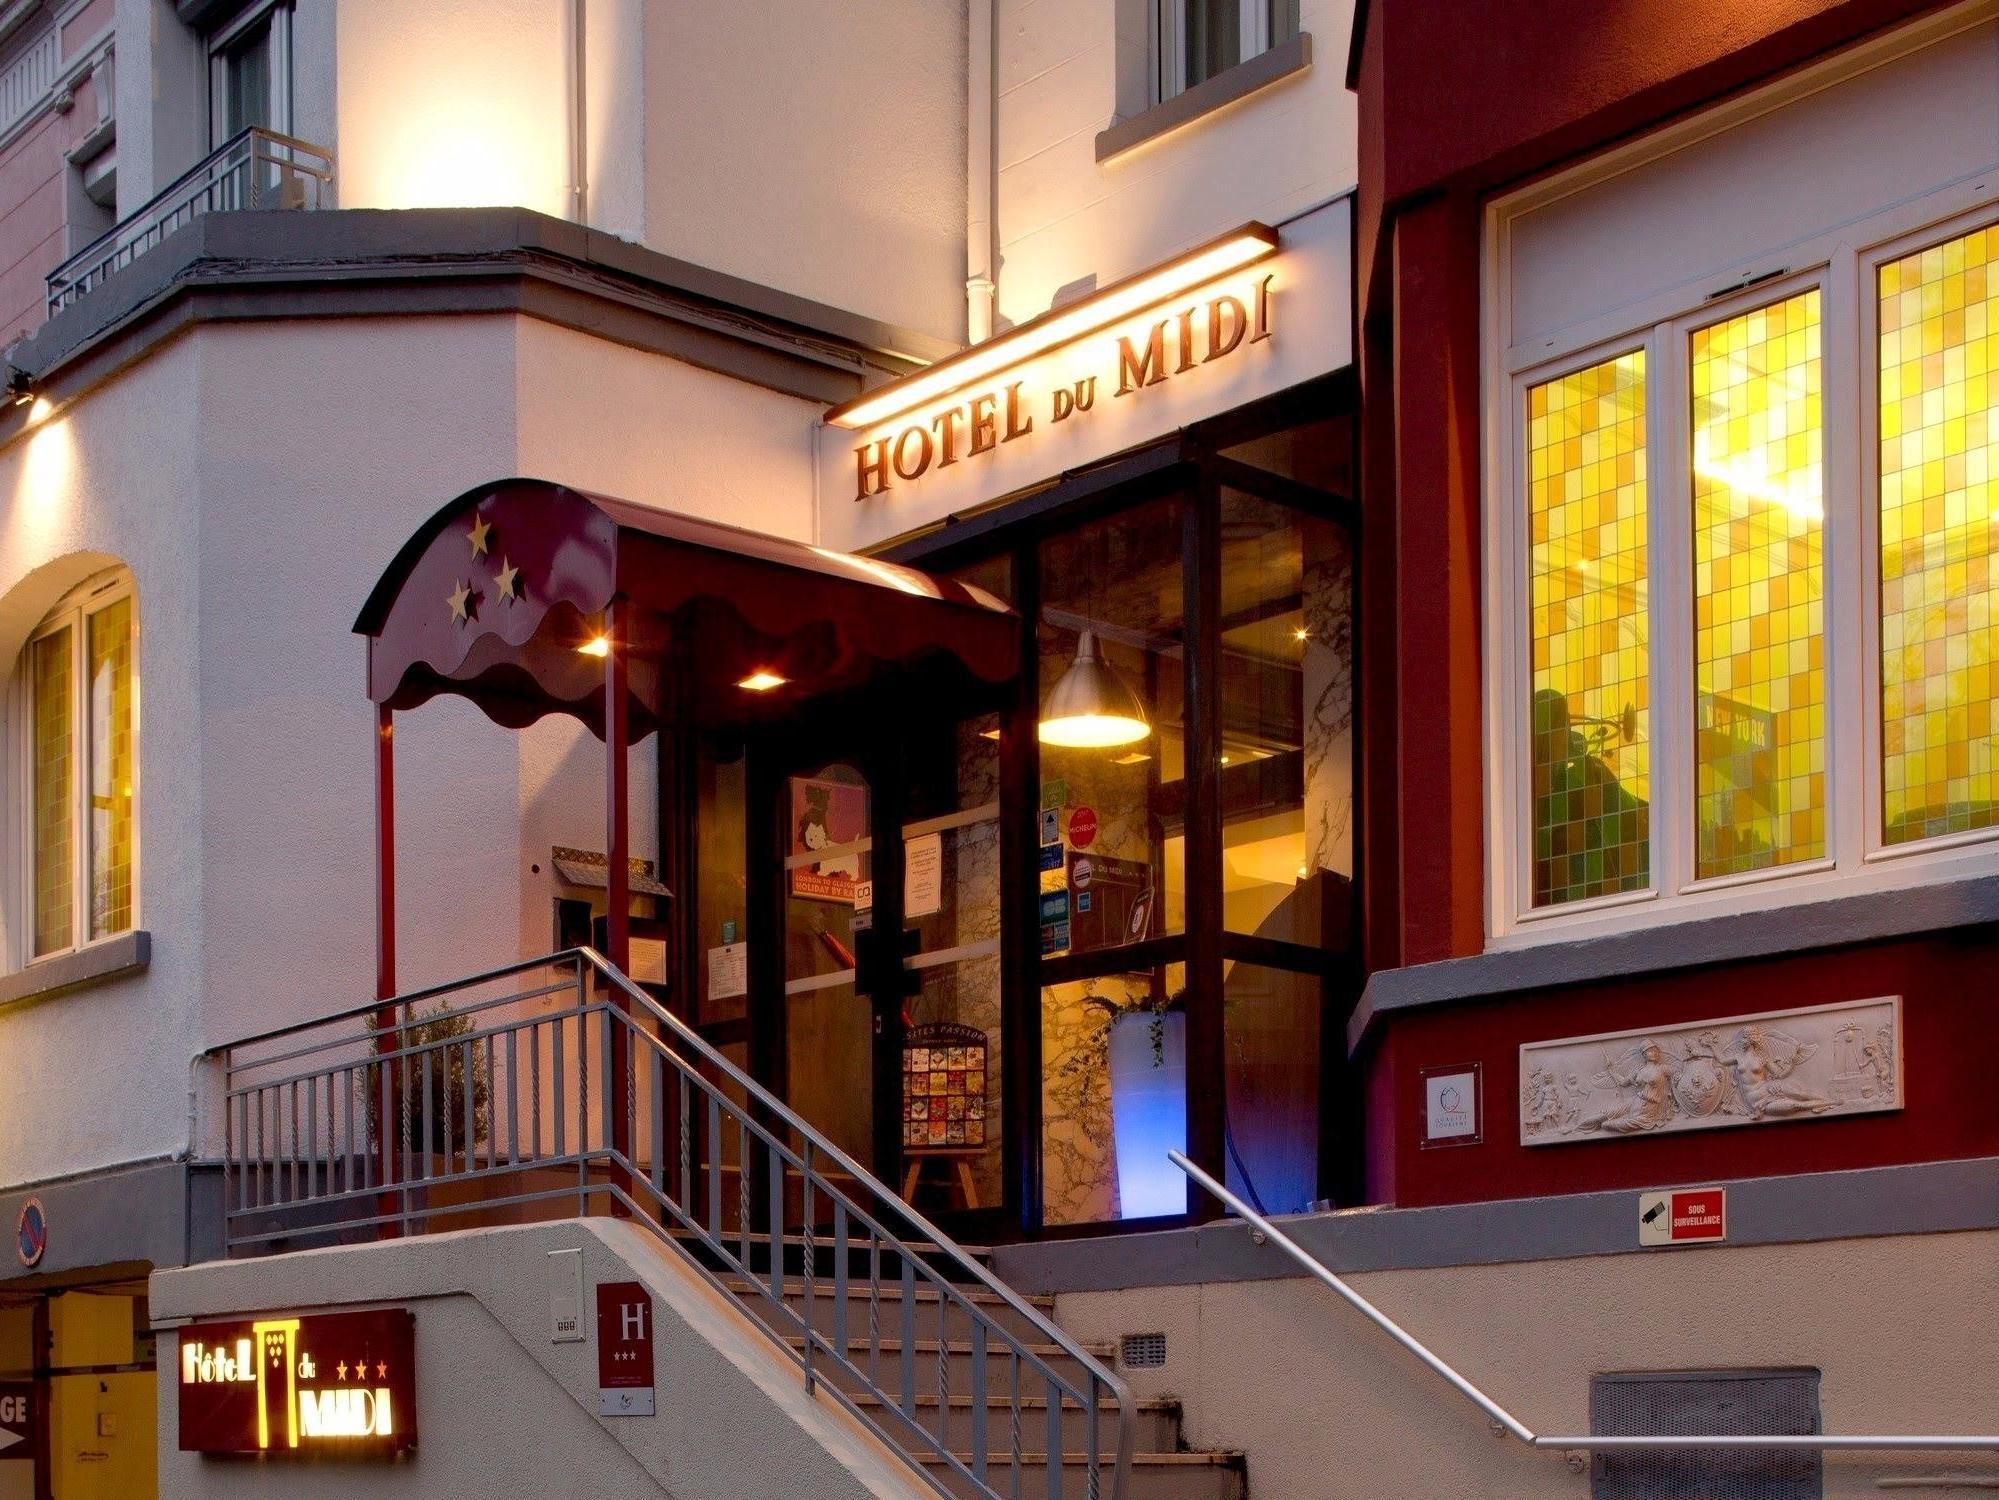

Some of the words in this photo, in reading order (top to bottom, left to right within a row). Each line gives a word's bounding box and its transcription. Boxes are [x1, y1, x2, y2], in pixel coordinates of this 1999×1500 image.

[853, 381, 1033, 502] HOTEL
[1051, 375, 1097, 424] DU
[1114, 274, 1274, 398] MIDI
[1069, 823, 1097, 834] MICHELIN
[797, 882, 829, 896] HOLIDAY
[1688, 1204, 1706, 1215] SOUS
[1673, 1215, 1721, 1228] SURVEILLANCE
[620, 1302, 646, 1341] H
[298, 1352, 316, 1379] du
[298, 1387, 392, 1437] MIDI
